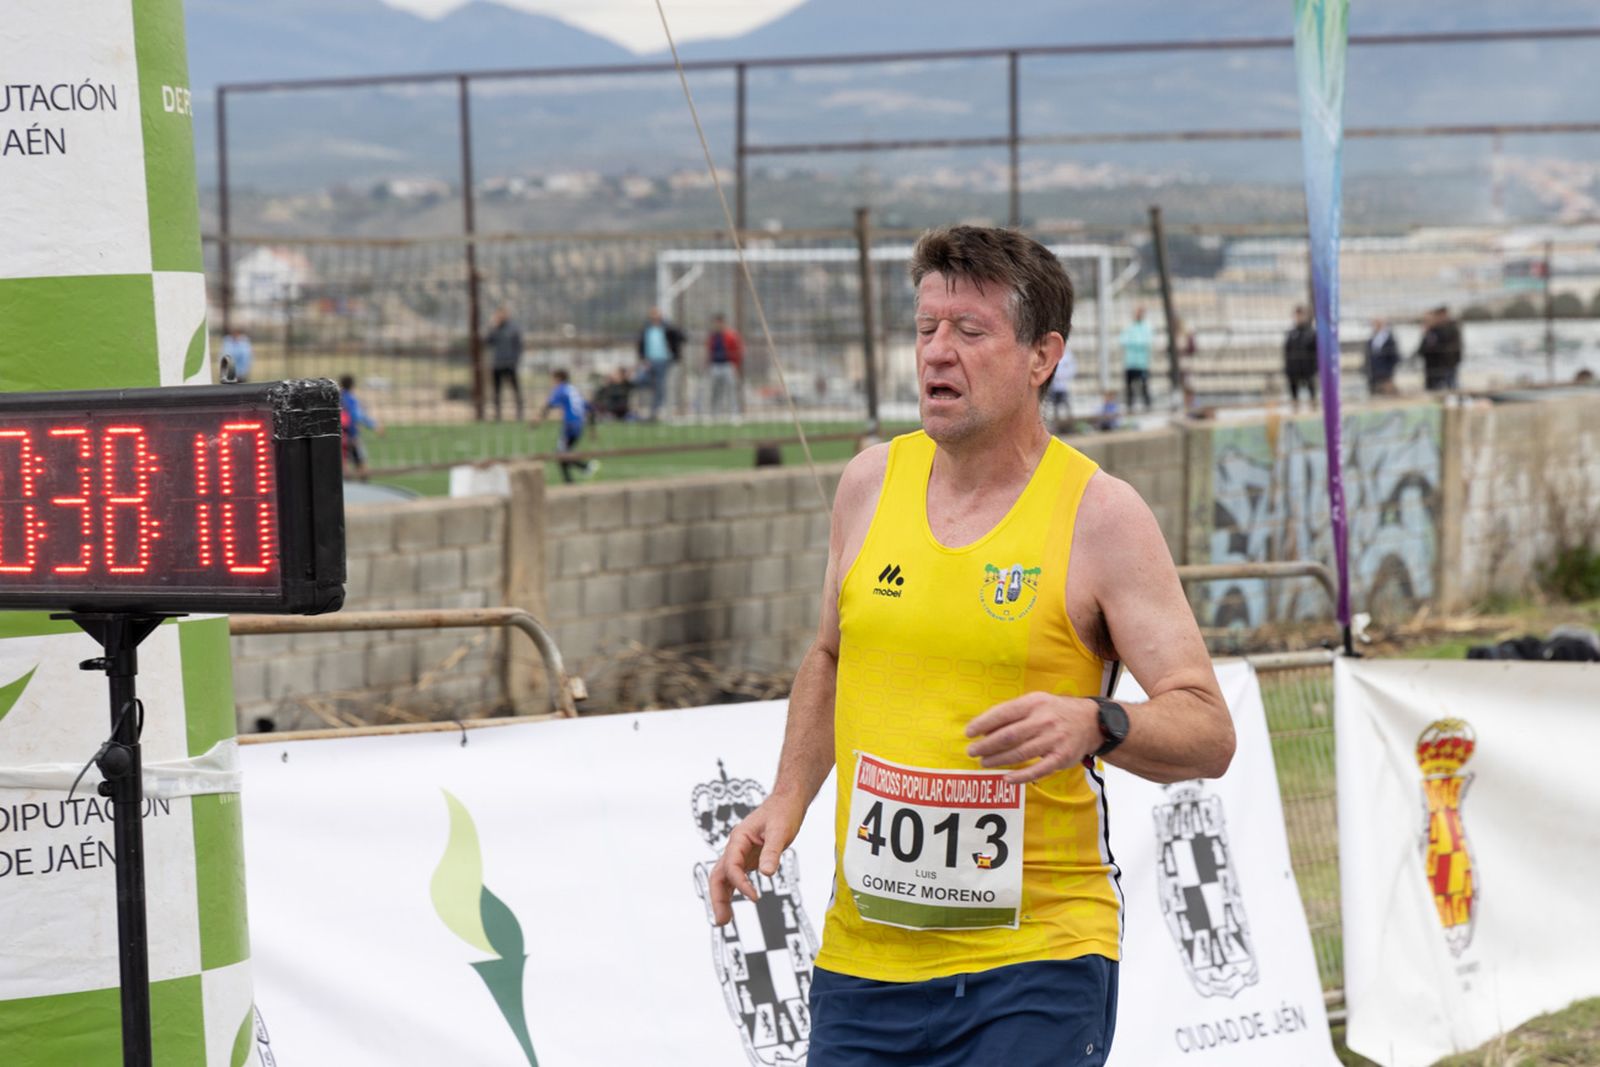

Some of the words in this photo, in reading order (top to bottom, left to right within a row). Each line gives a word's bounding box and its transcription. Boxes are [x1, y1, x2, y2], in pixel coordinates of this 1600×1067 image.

[873, 588, 902, 598] mobel
[876, 767, 901, 797] CROSS
[901, 774, 944, 803] POPULAR
[944, 779, 979, 803] CIUDAD
[980, 780, 993, 804] DE
[857, 801, 1009, 870] 4013
[0, 848, 34, 878] DE
[41, 836, 117, 874] JAÉN
[915, 869, 938, 880] LUIS
[862, 874, 917, 897] GOMEZ
[921, 886, 996, 903] MORENO
[1175, 1018, 1240, 1053] CIUDAD
[1240, 1012, 1268, 1040] DE
